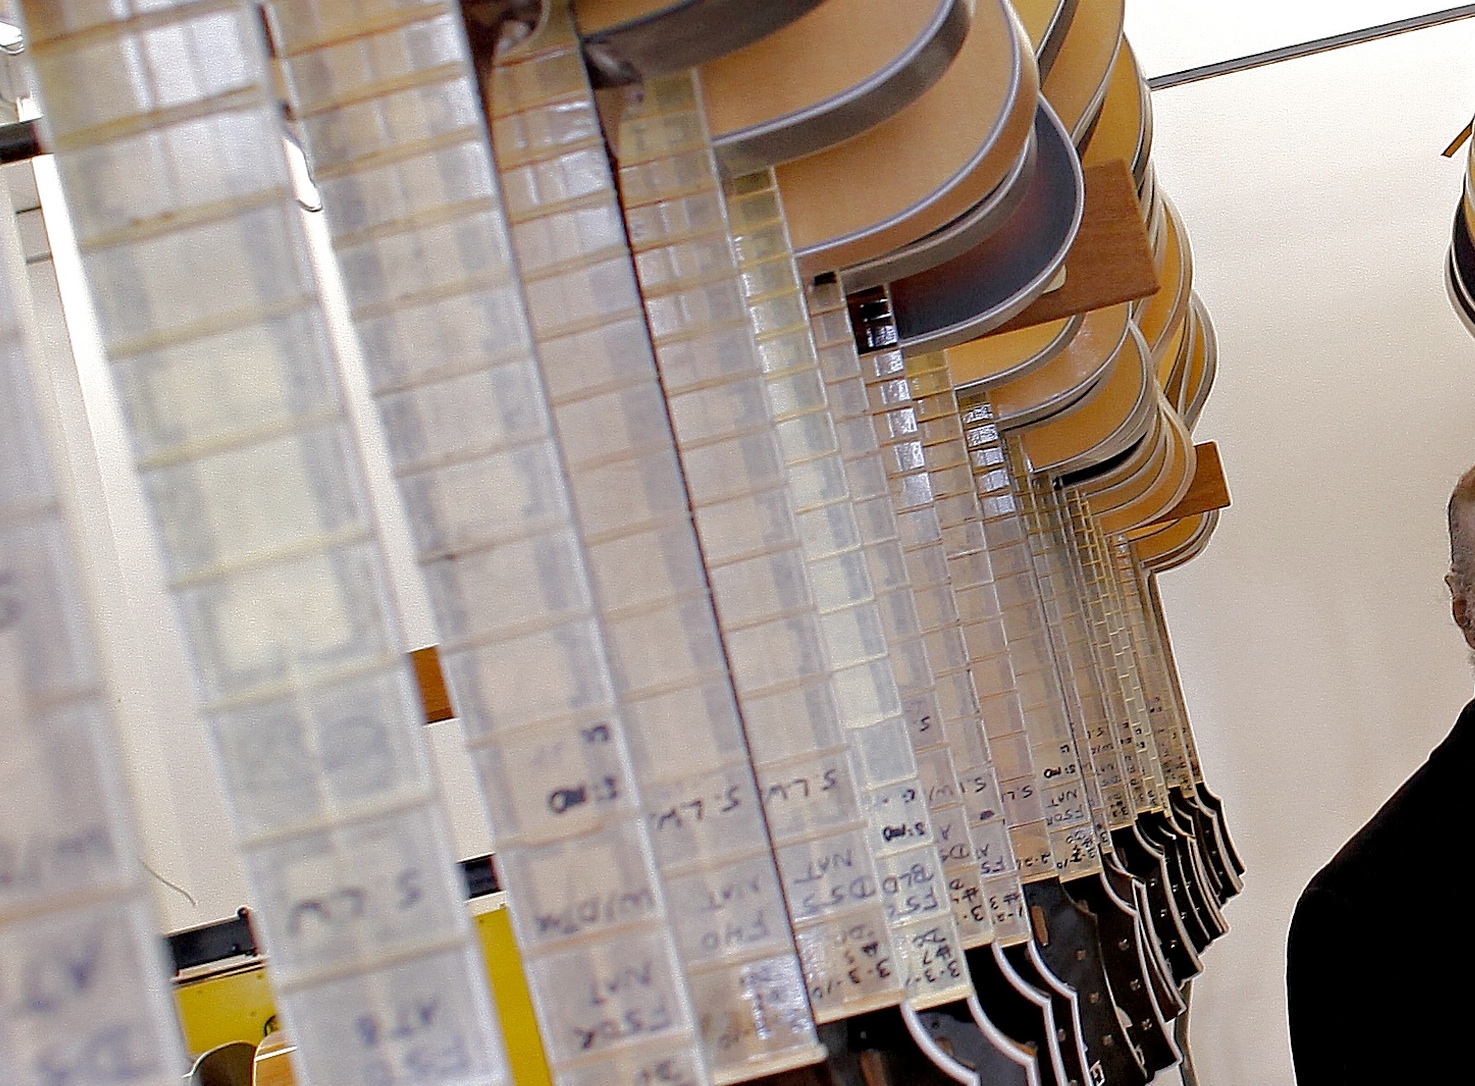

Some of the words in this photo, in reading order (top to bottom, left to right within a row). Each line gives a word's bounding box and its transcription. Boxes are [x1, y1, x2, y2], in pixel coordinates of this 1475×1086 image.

[1047, 788, 1077, 807] NAT
[794, 849, 852, 884] NAT
[883, 864, 934, 893] BLD
[589, 962, 651, 1006] NAT
